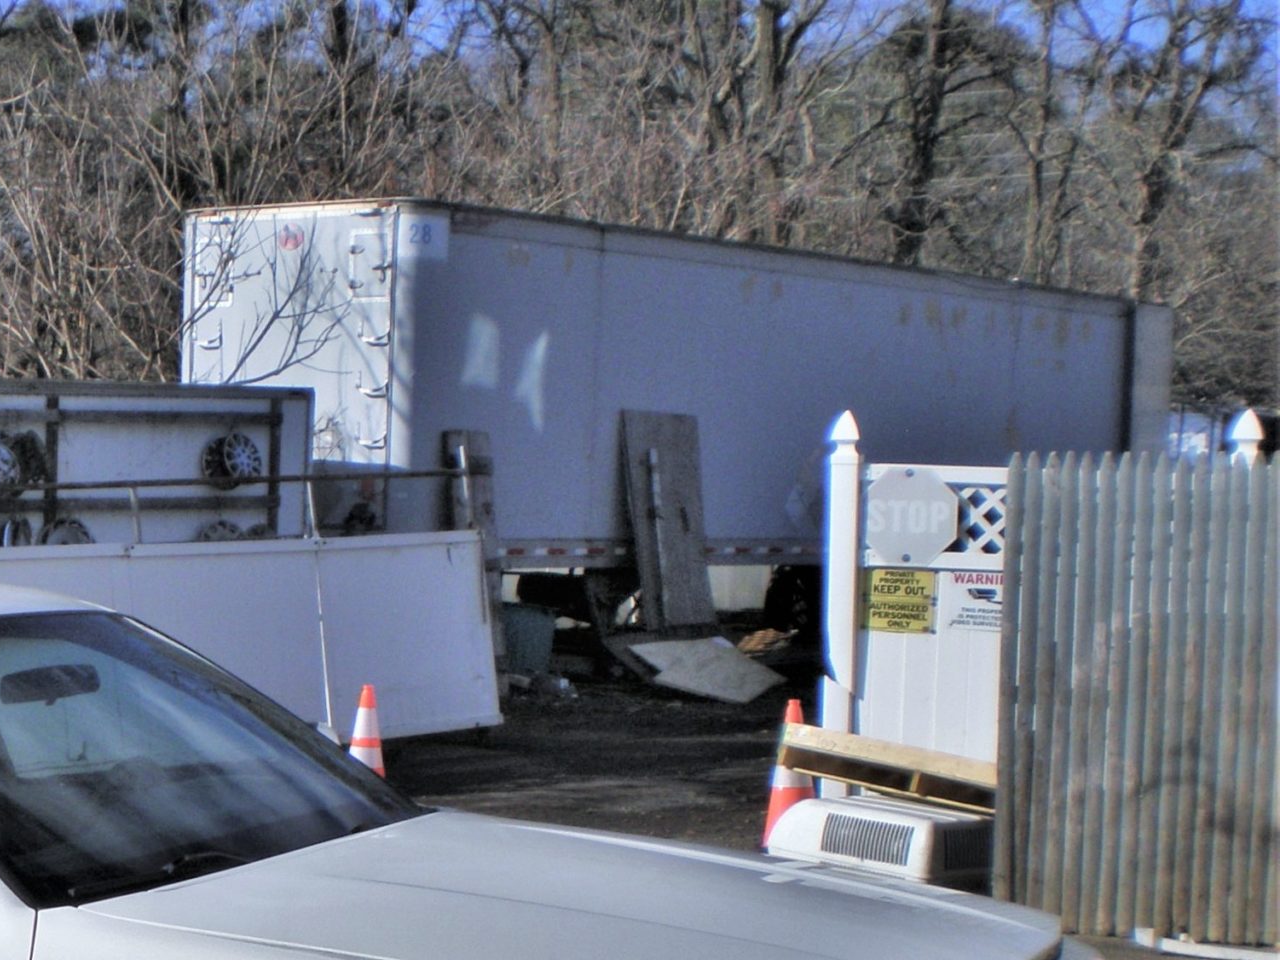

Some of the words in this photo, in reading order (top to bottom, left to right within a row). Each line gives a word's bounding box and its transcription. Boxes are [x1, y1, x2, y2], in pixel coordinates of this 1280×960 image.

[409, 223, 432, 245] 28
[868, 499, 950, 533] STOP
[878, 577, 920, 585] PROPERTY
[873, 584, 901, 594] KEEP
[904, 586, 926, 595] OUT
[871, 602, 928, 612] AUTHORIZED
[872, 610, 927, 621] PERSONNEL
[887, 619, 911, 628] ONLY
